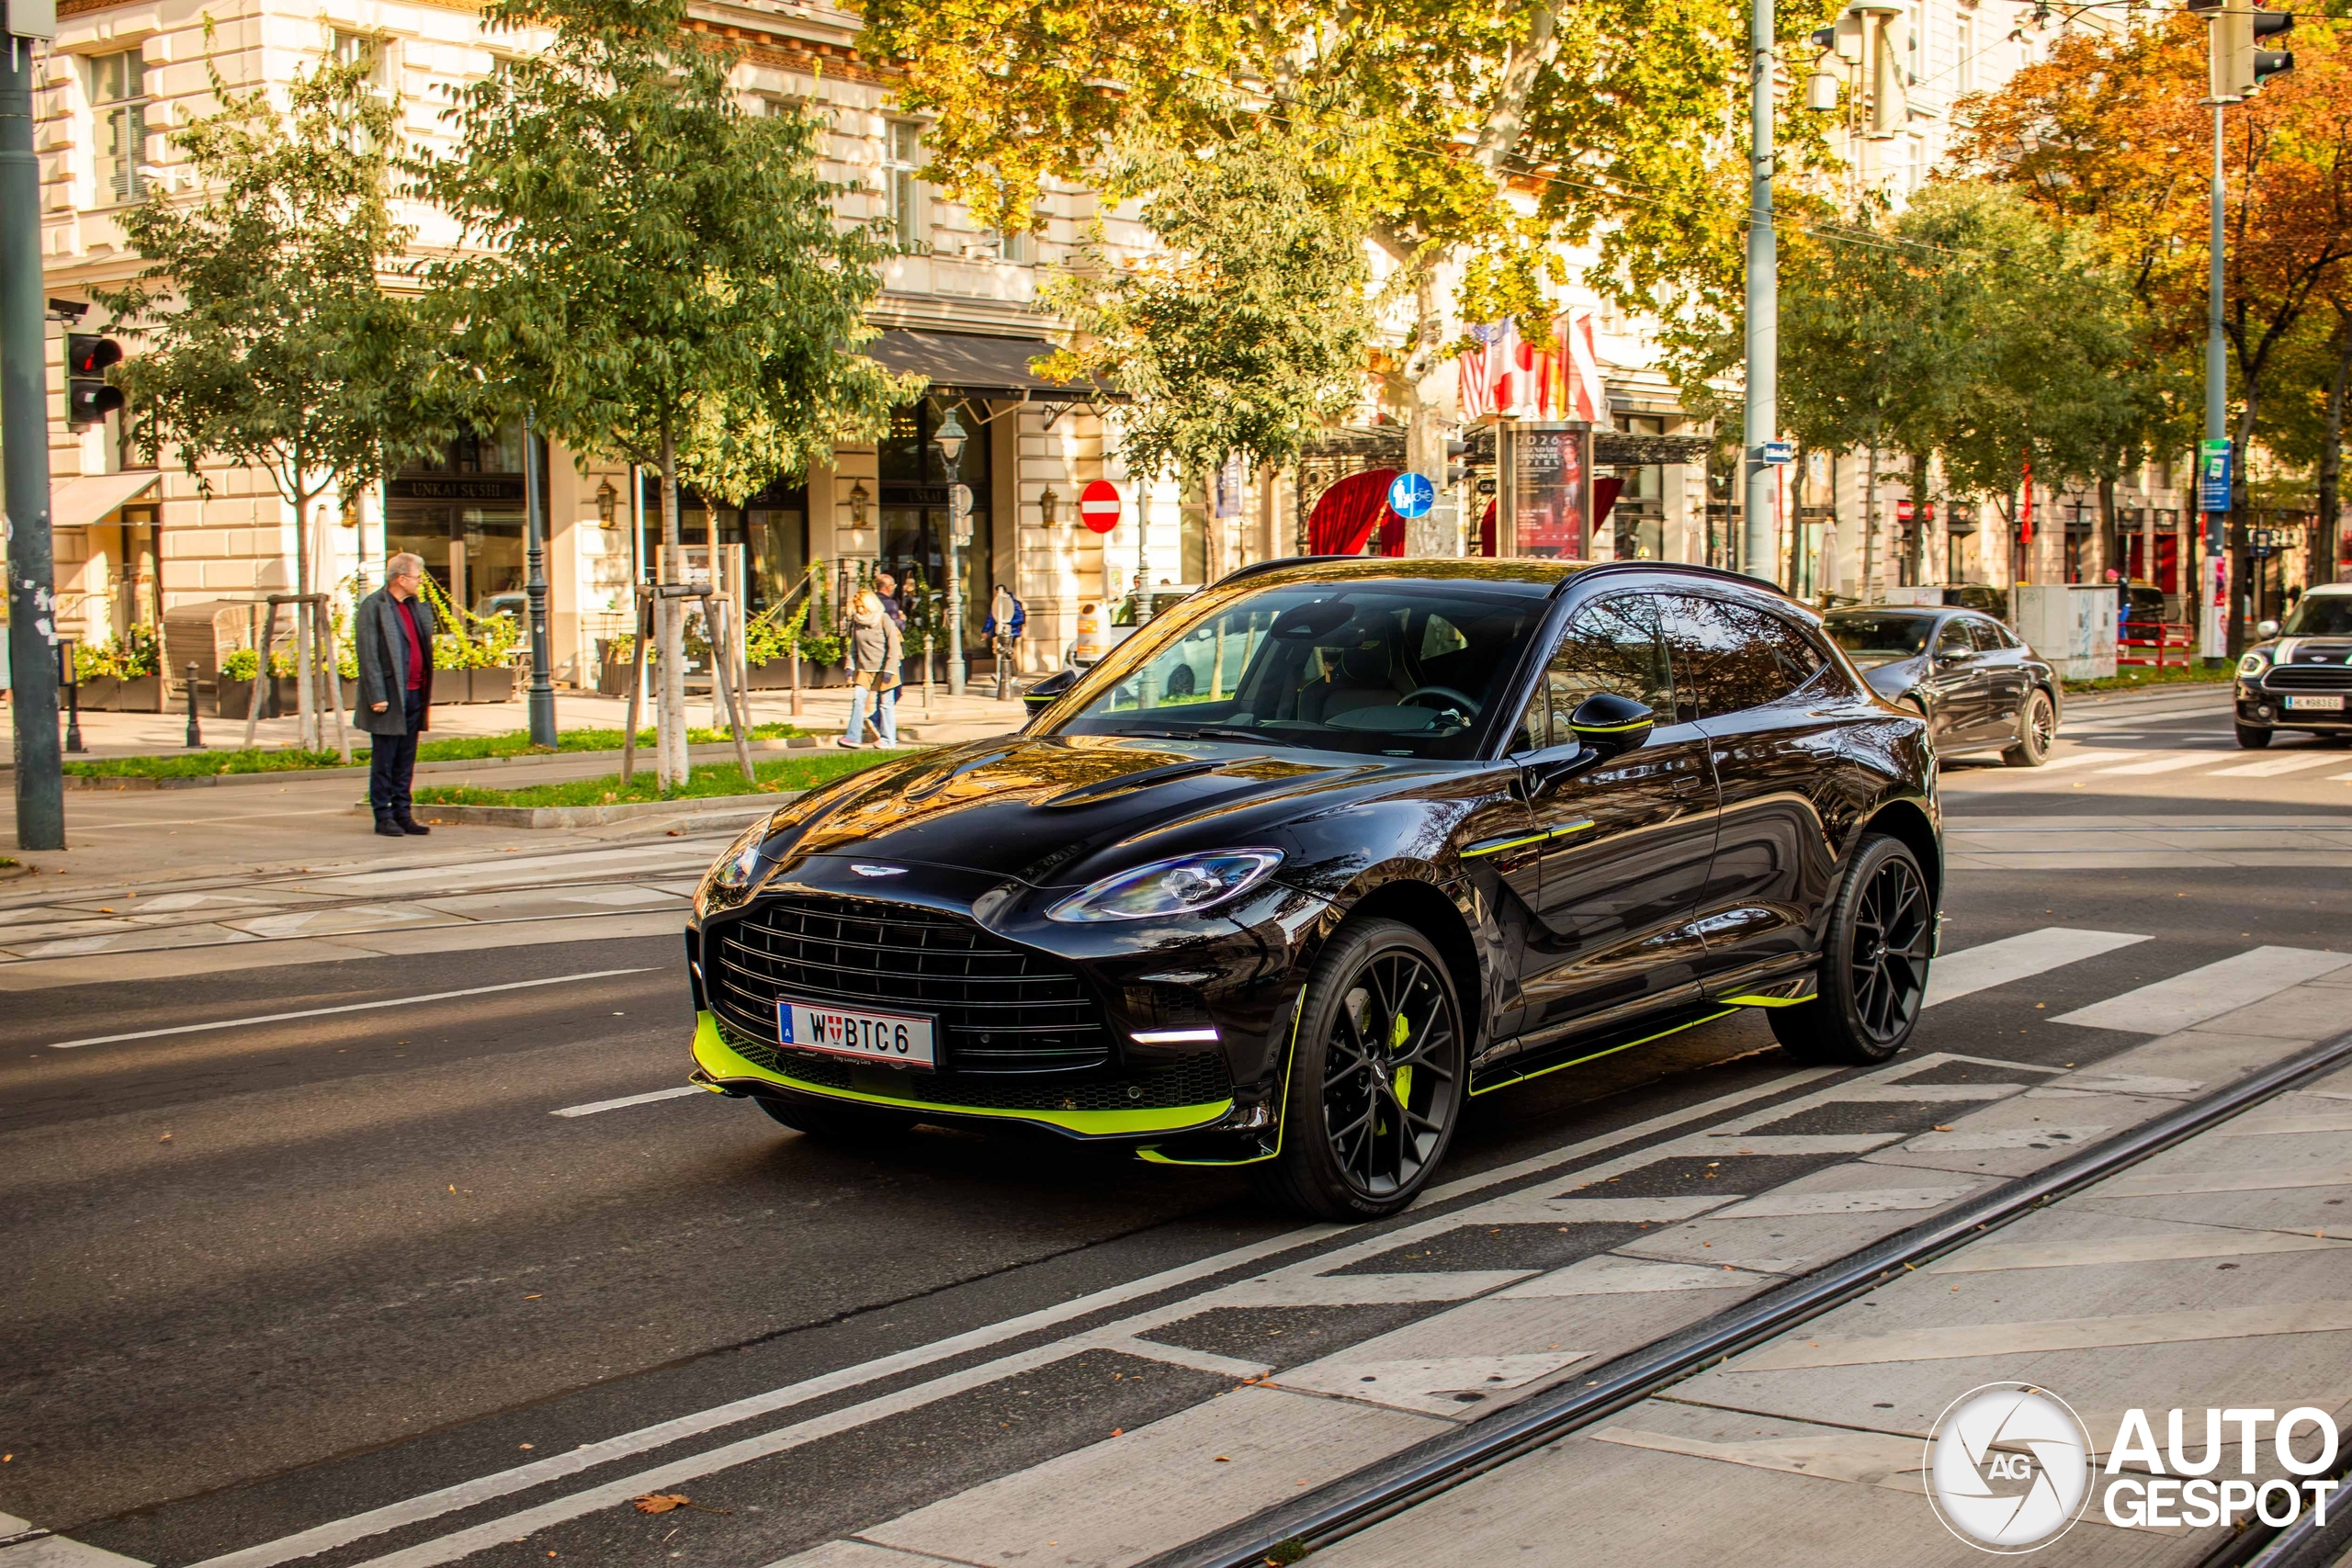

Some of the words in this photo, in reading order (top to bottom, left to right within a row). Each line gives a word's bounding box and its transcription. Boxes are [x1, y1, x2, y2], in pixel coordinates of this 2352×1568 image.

[1517, 435, 1559, 446] 2026
[413, 483, 458, 496] UNKAI
[460, 484, 500, 497] SUSHI
[784, 1028, 791, 1038] A
[810, 1012, 826, 1043] W
[844, 1017, 888, 1051] BTC
[895, 1023, 909, 1054] 6
